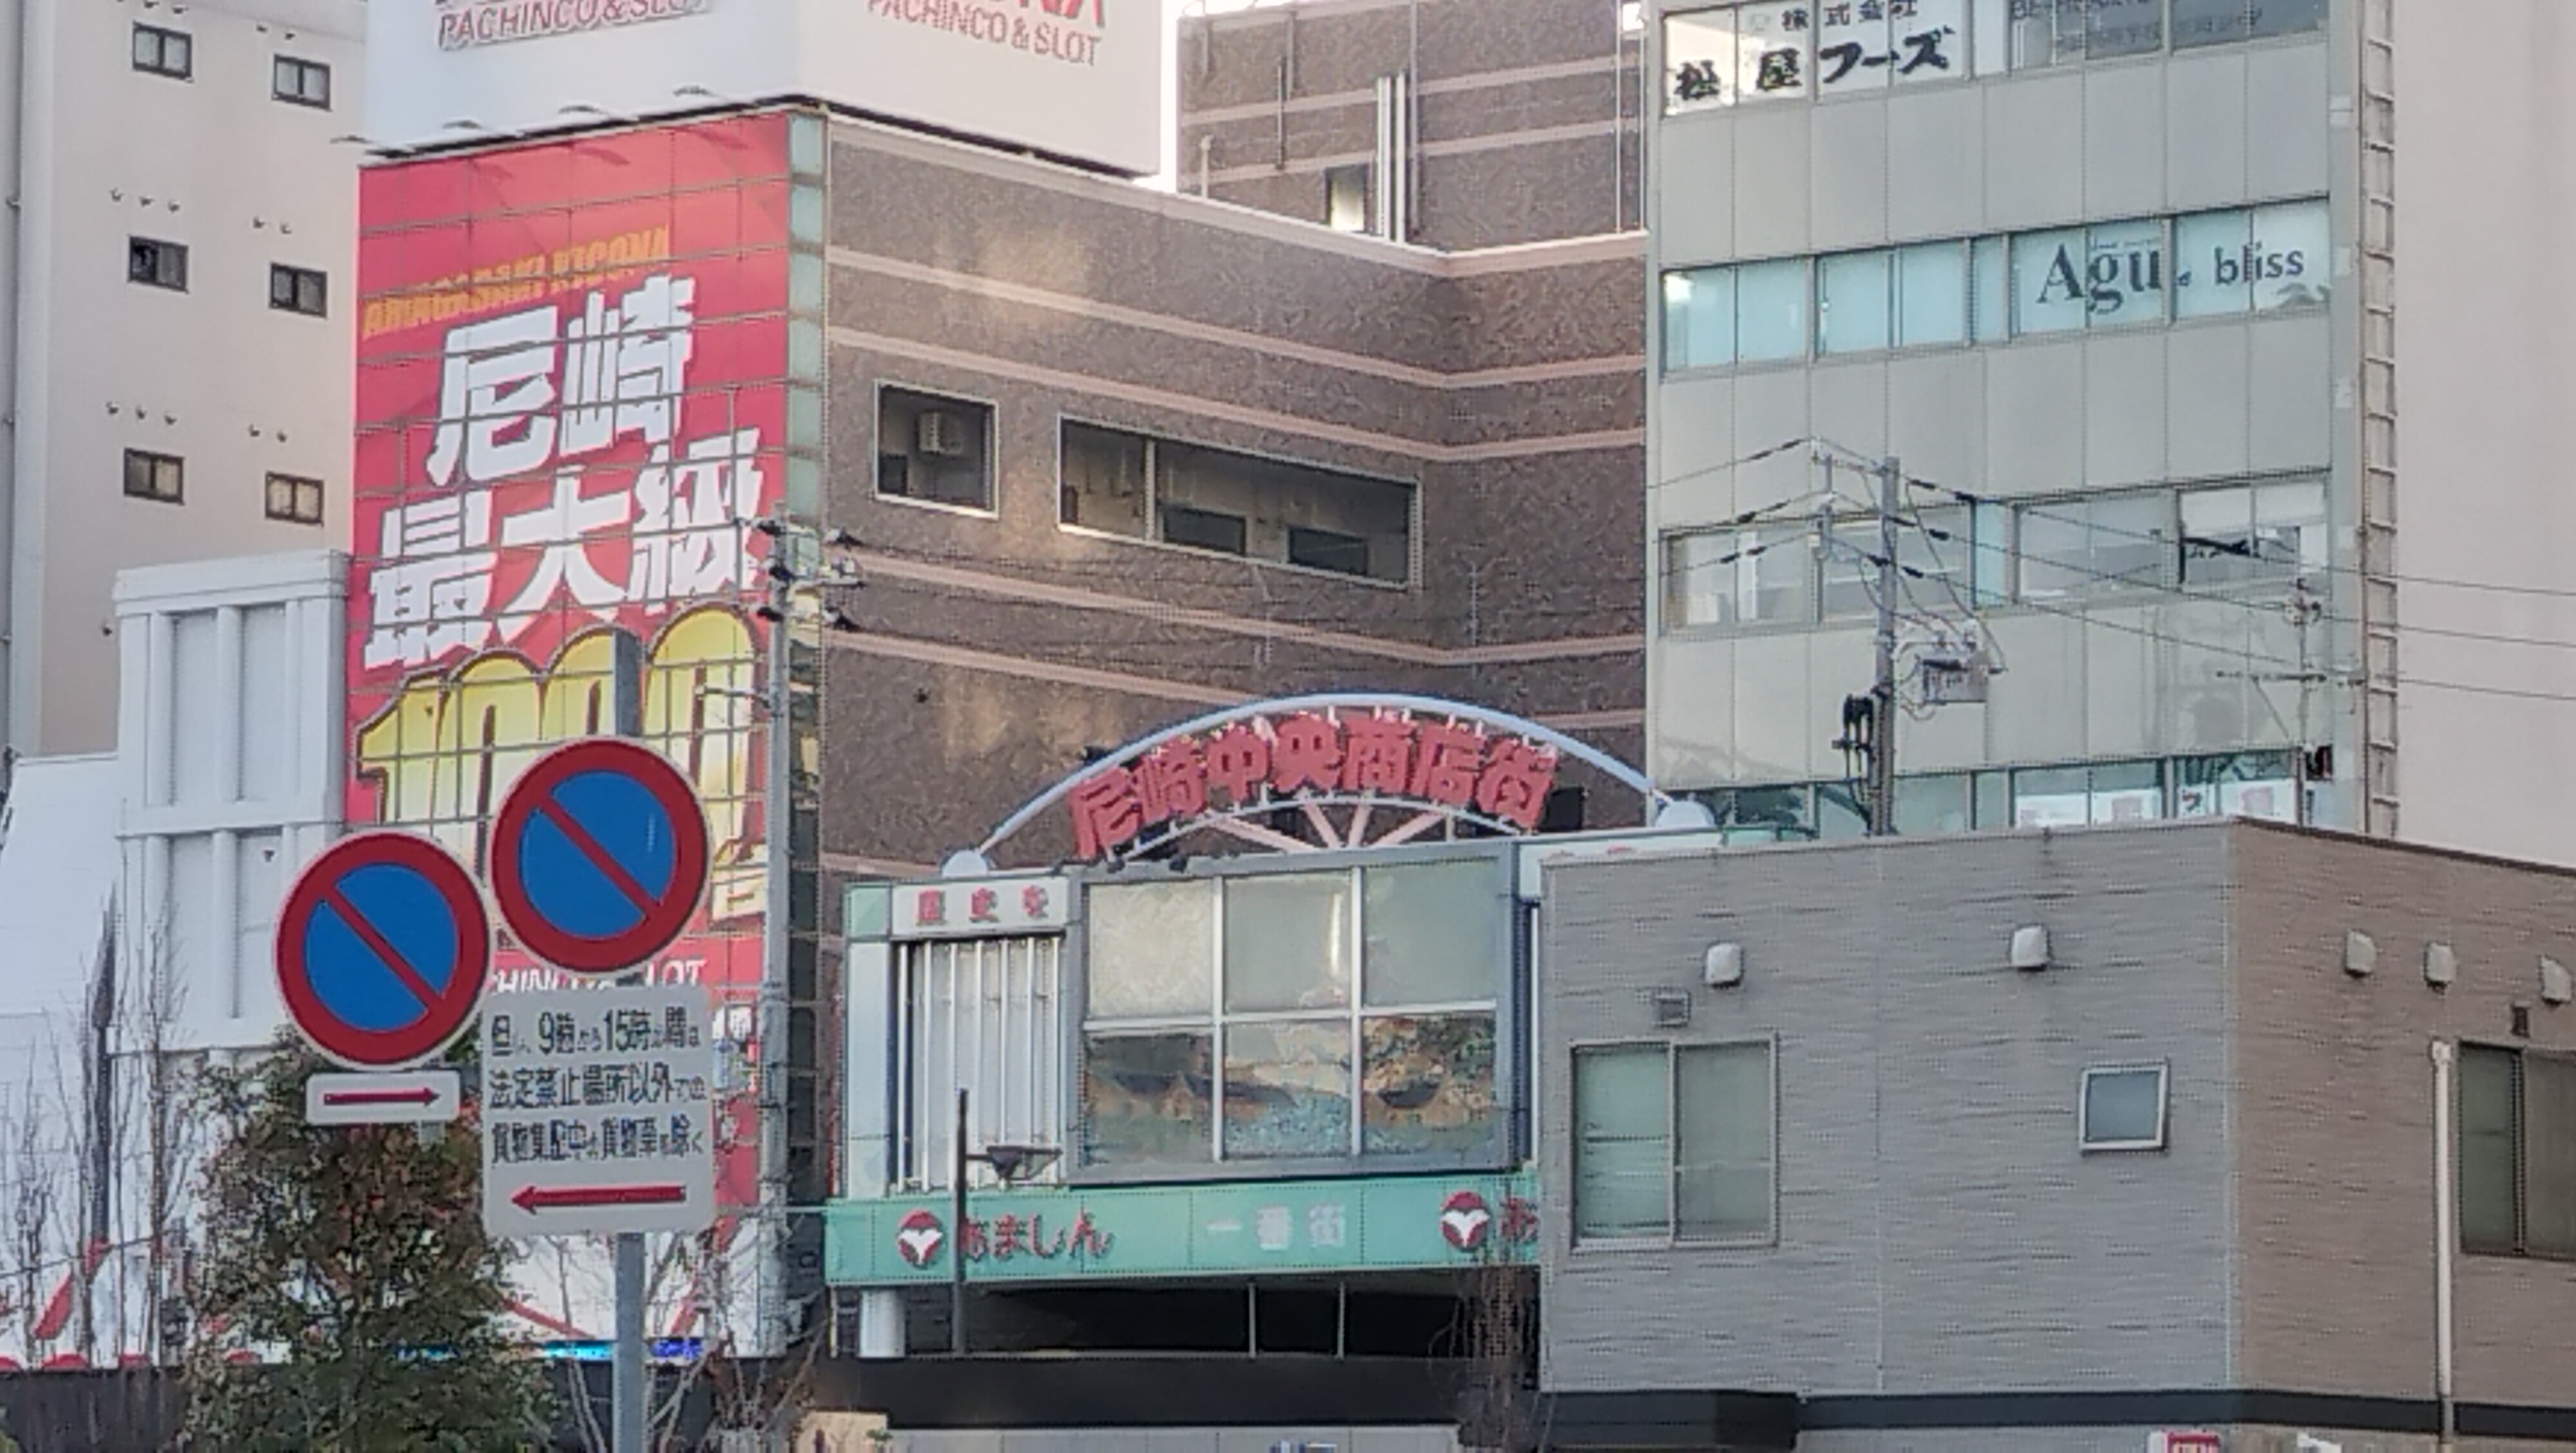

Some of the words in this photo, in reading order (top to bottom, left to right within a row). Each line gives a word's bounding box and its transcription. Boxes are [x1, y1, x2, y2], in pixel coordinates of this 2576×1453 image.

[1674, 24, 1955, 100] 松屋フーズ
[2214, 241, 2304, 285] bliss
[426, 273, 696, 487] 尼崎
[363, 428, 764, 670] 最大級
[1069, 710, 1557, 860] 尼崎中央商店街
